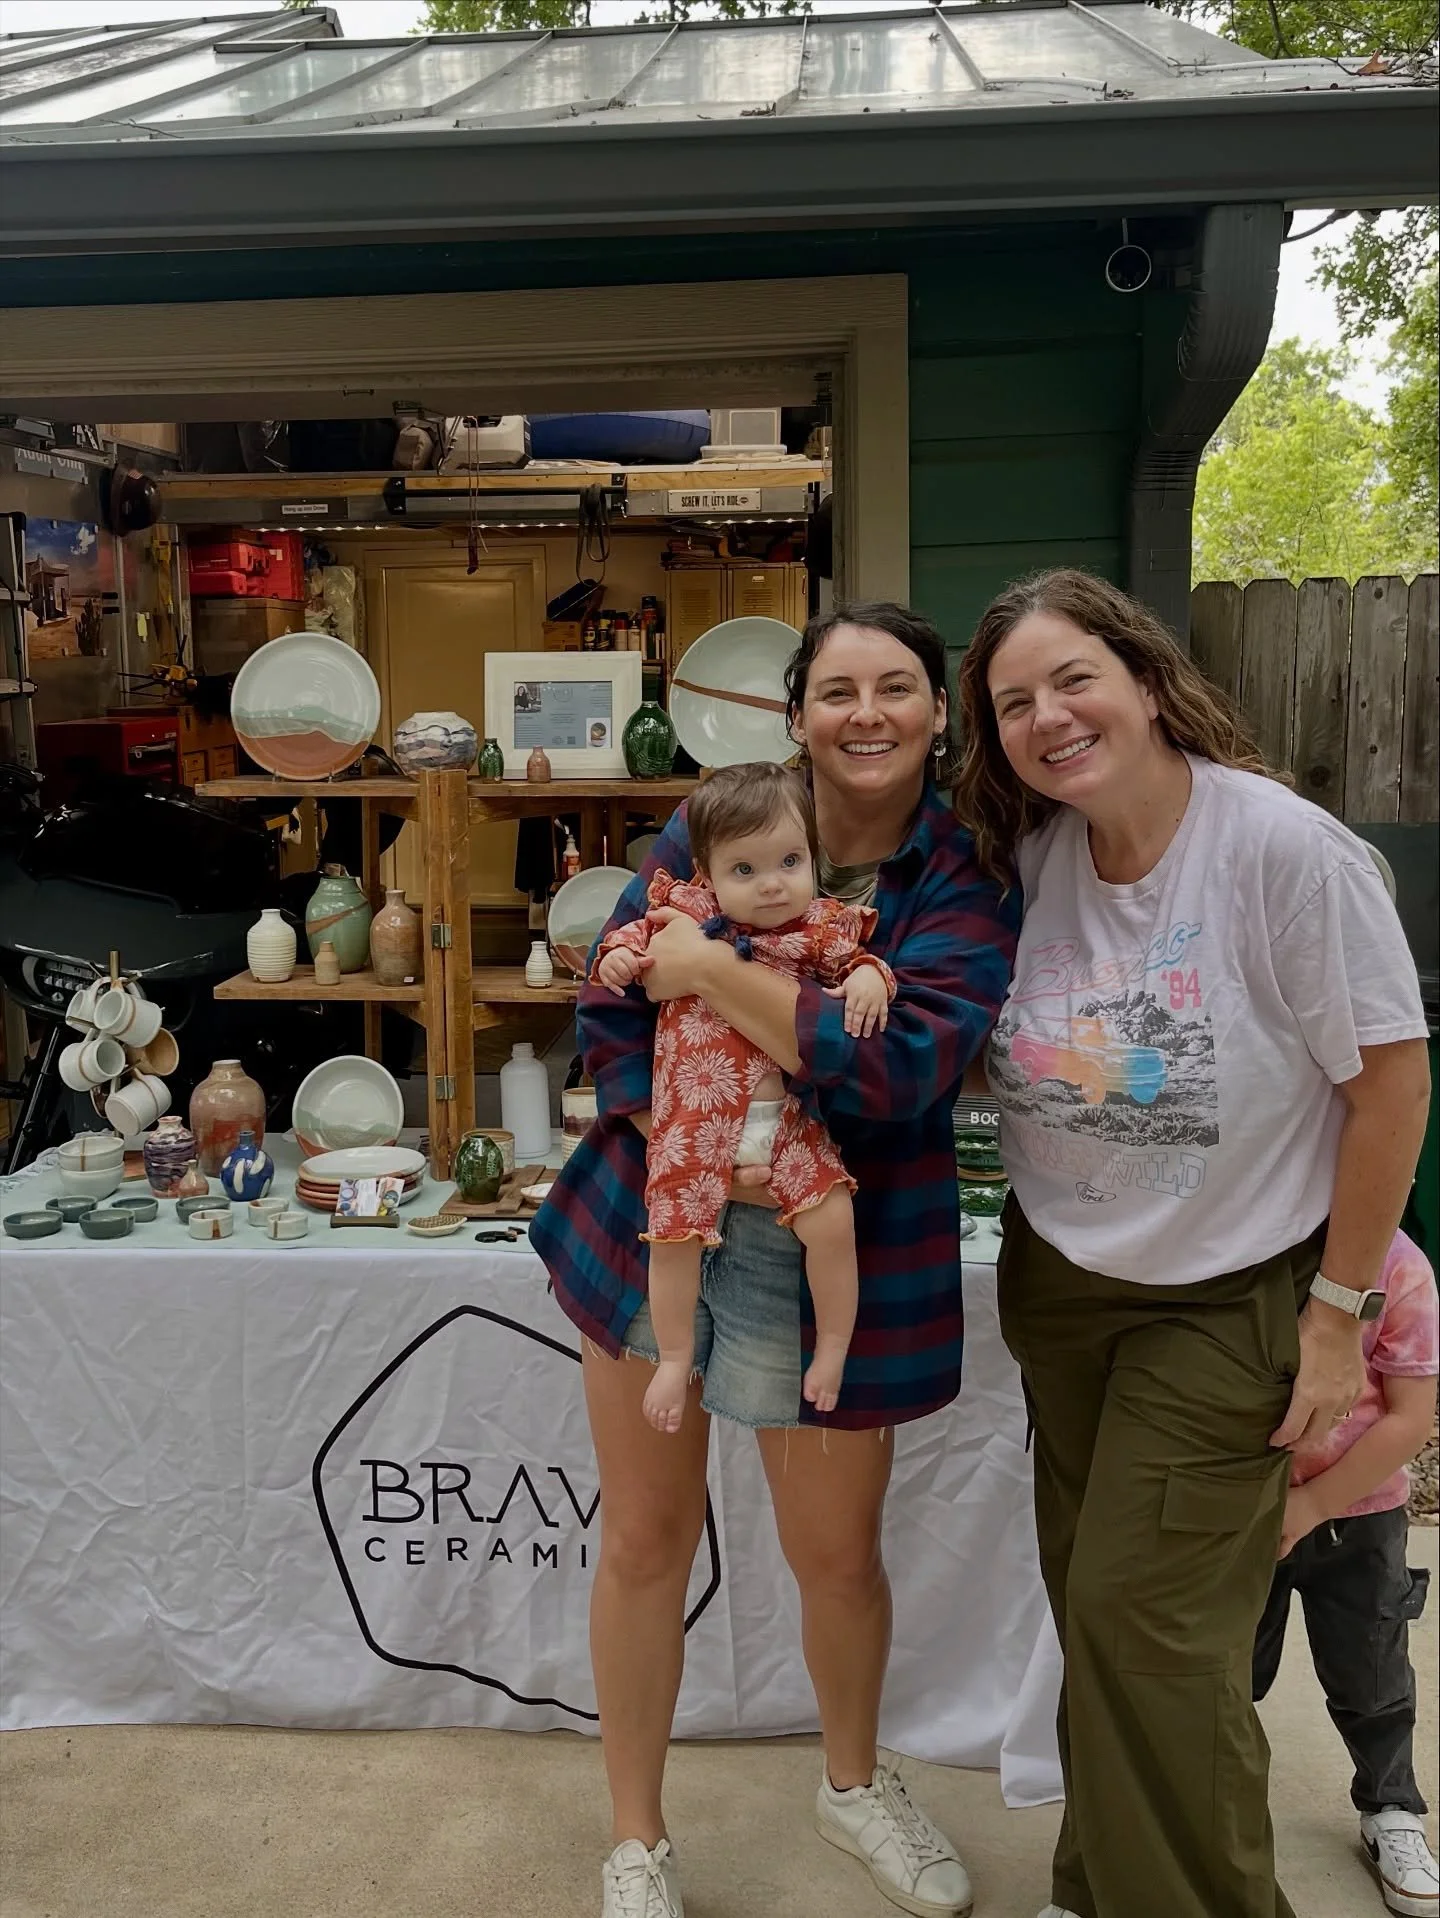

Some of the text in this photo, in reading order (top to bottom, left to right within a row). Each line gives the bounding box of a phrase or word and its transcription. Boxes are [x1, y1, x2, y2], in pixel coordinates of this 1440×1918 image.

[681, 495, 701, 508] SCREW
[1096, 1144, 1207, 1199] WILD
[364, 1537, 587, 1568] CERAMI
